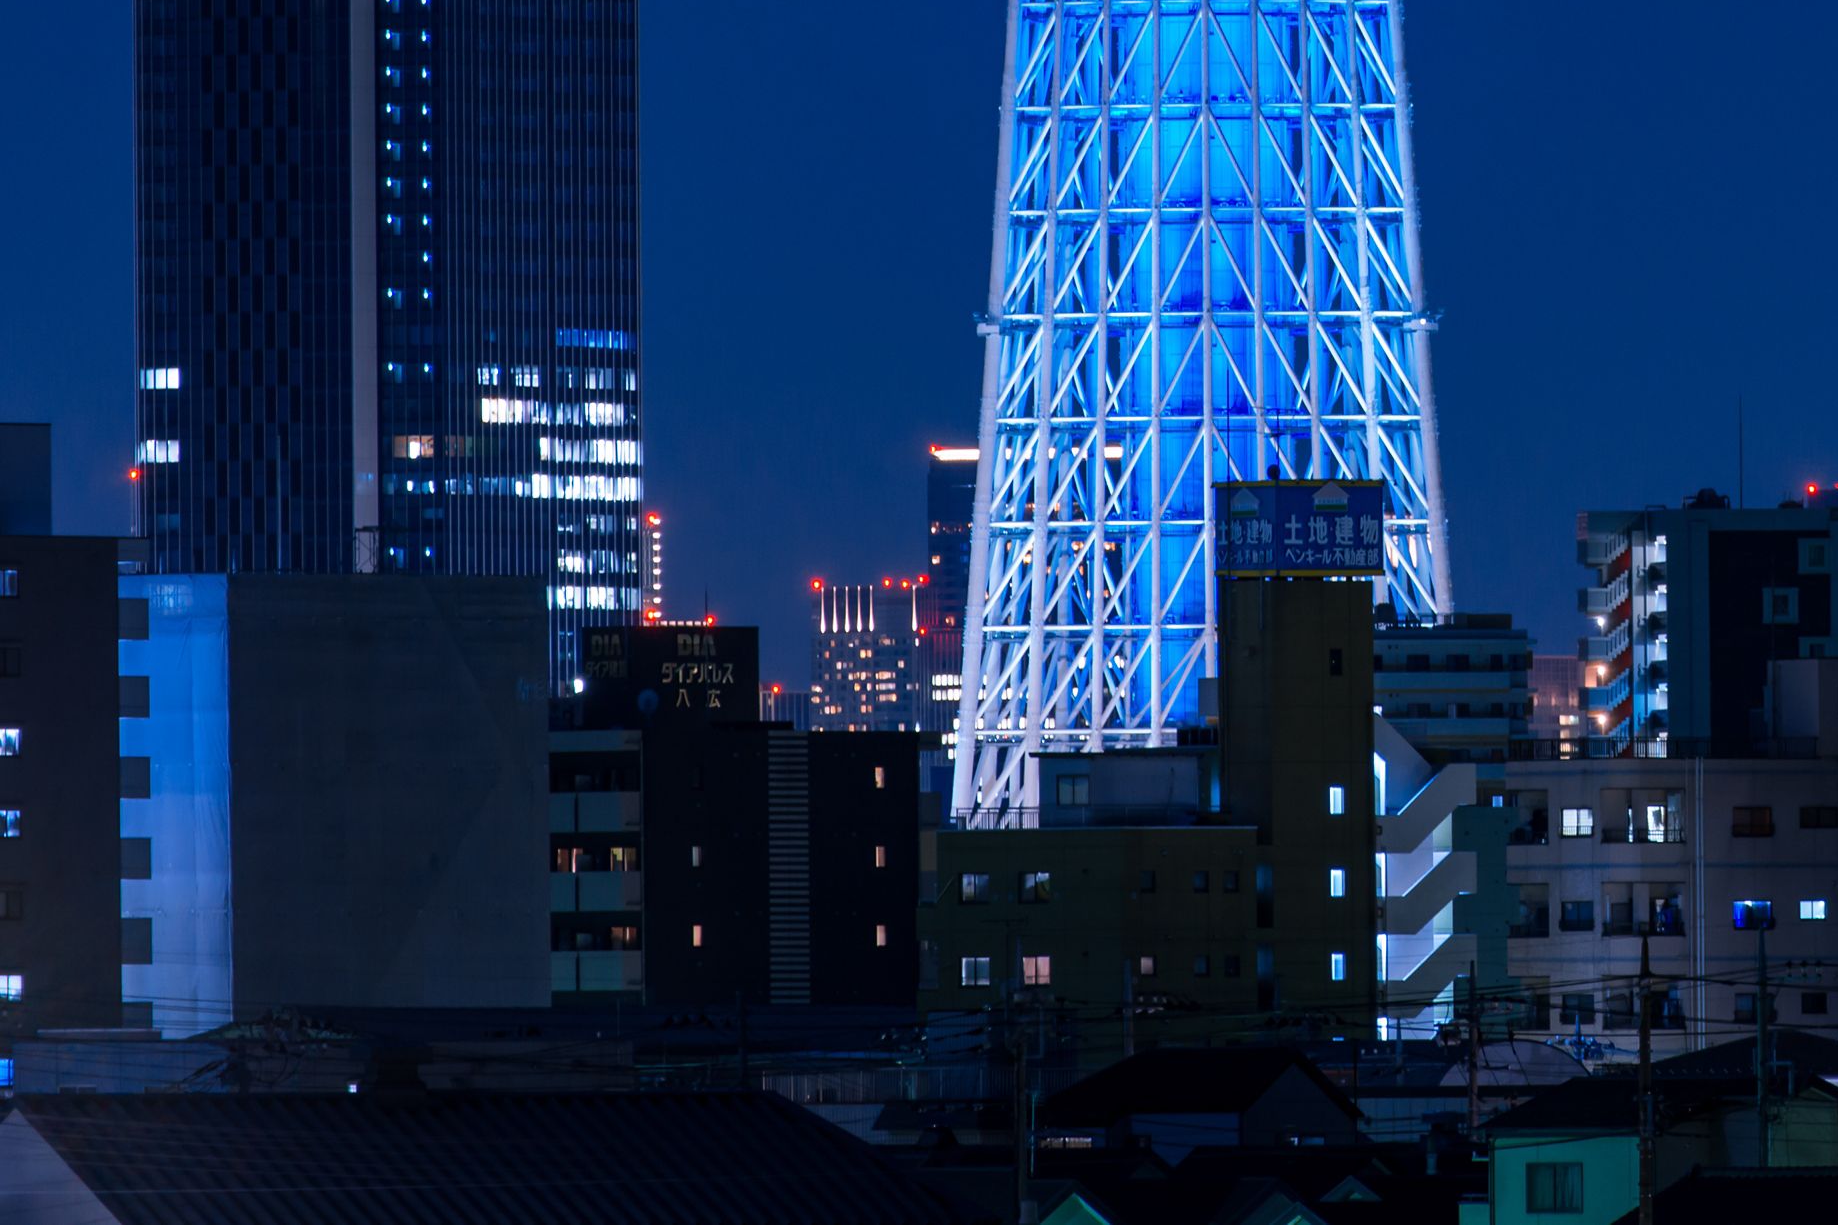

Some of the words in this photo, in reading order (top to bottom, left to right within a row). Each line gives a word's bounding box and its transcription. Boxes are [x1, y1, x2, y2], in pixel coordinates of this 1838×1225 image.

[591, 633, 623, 657] DIA
[676, 633, 717, 657] DIA
[660, 661, 735, 685] ダイアパレス
